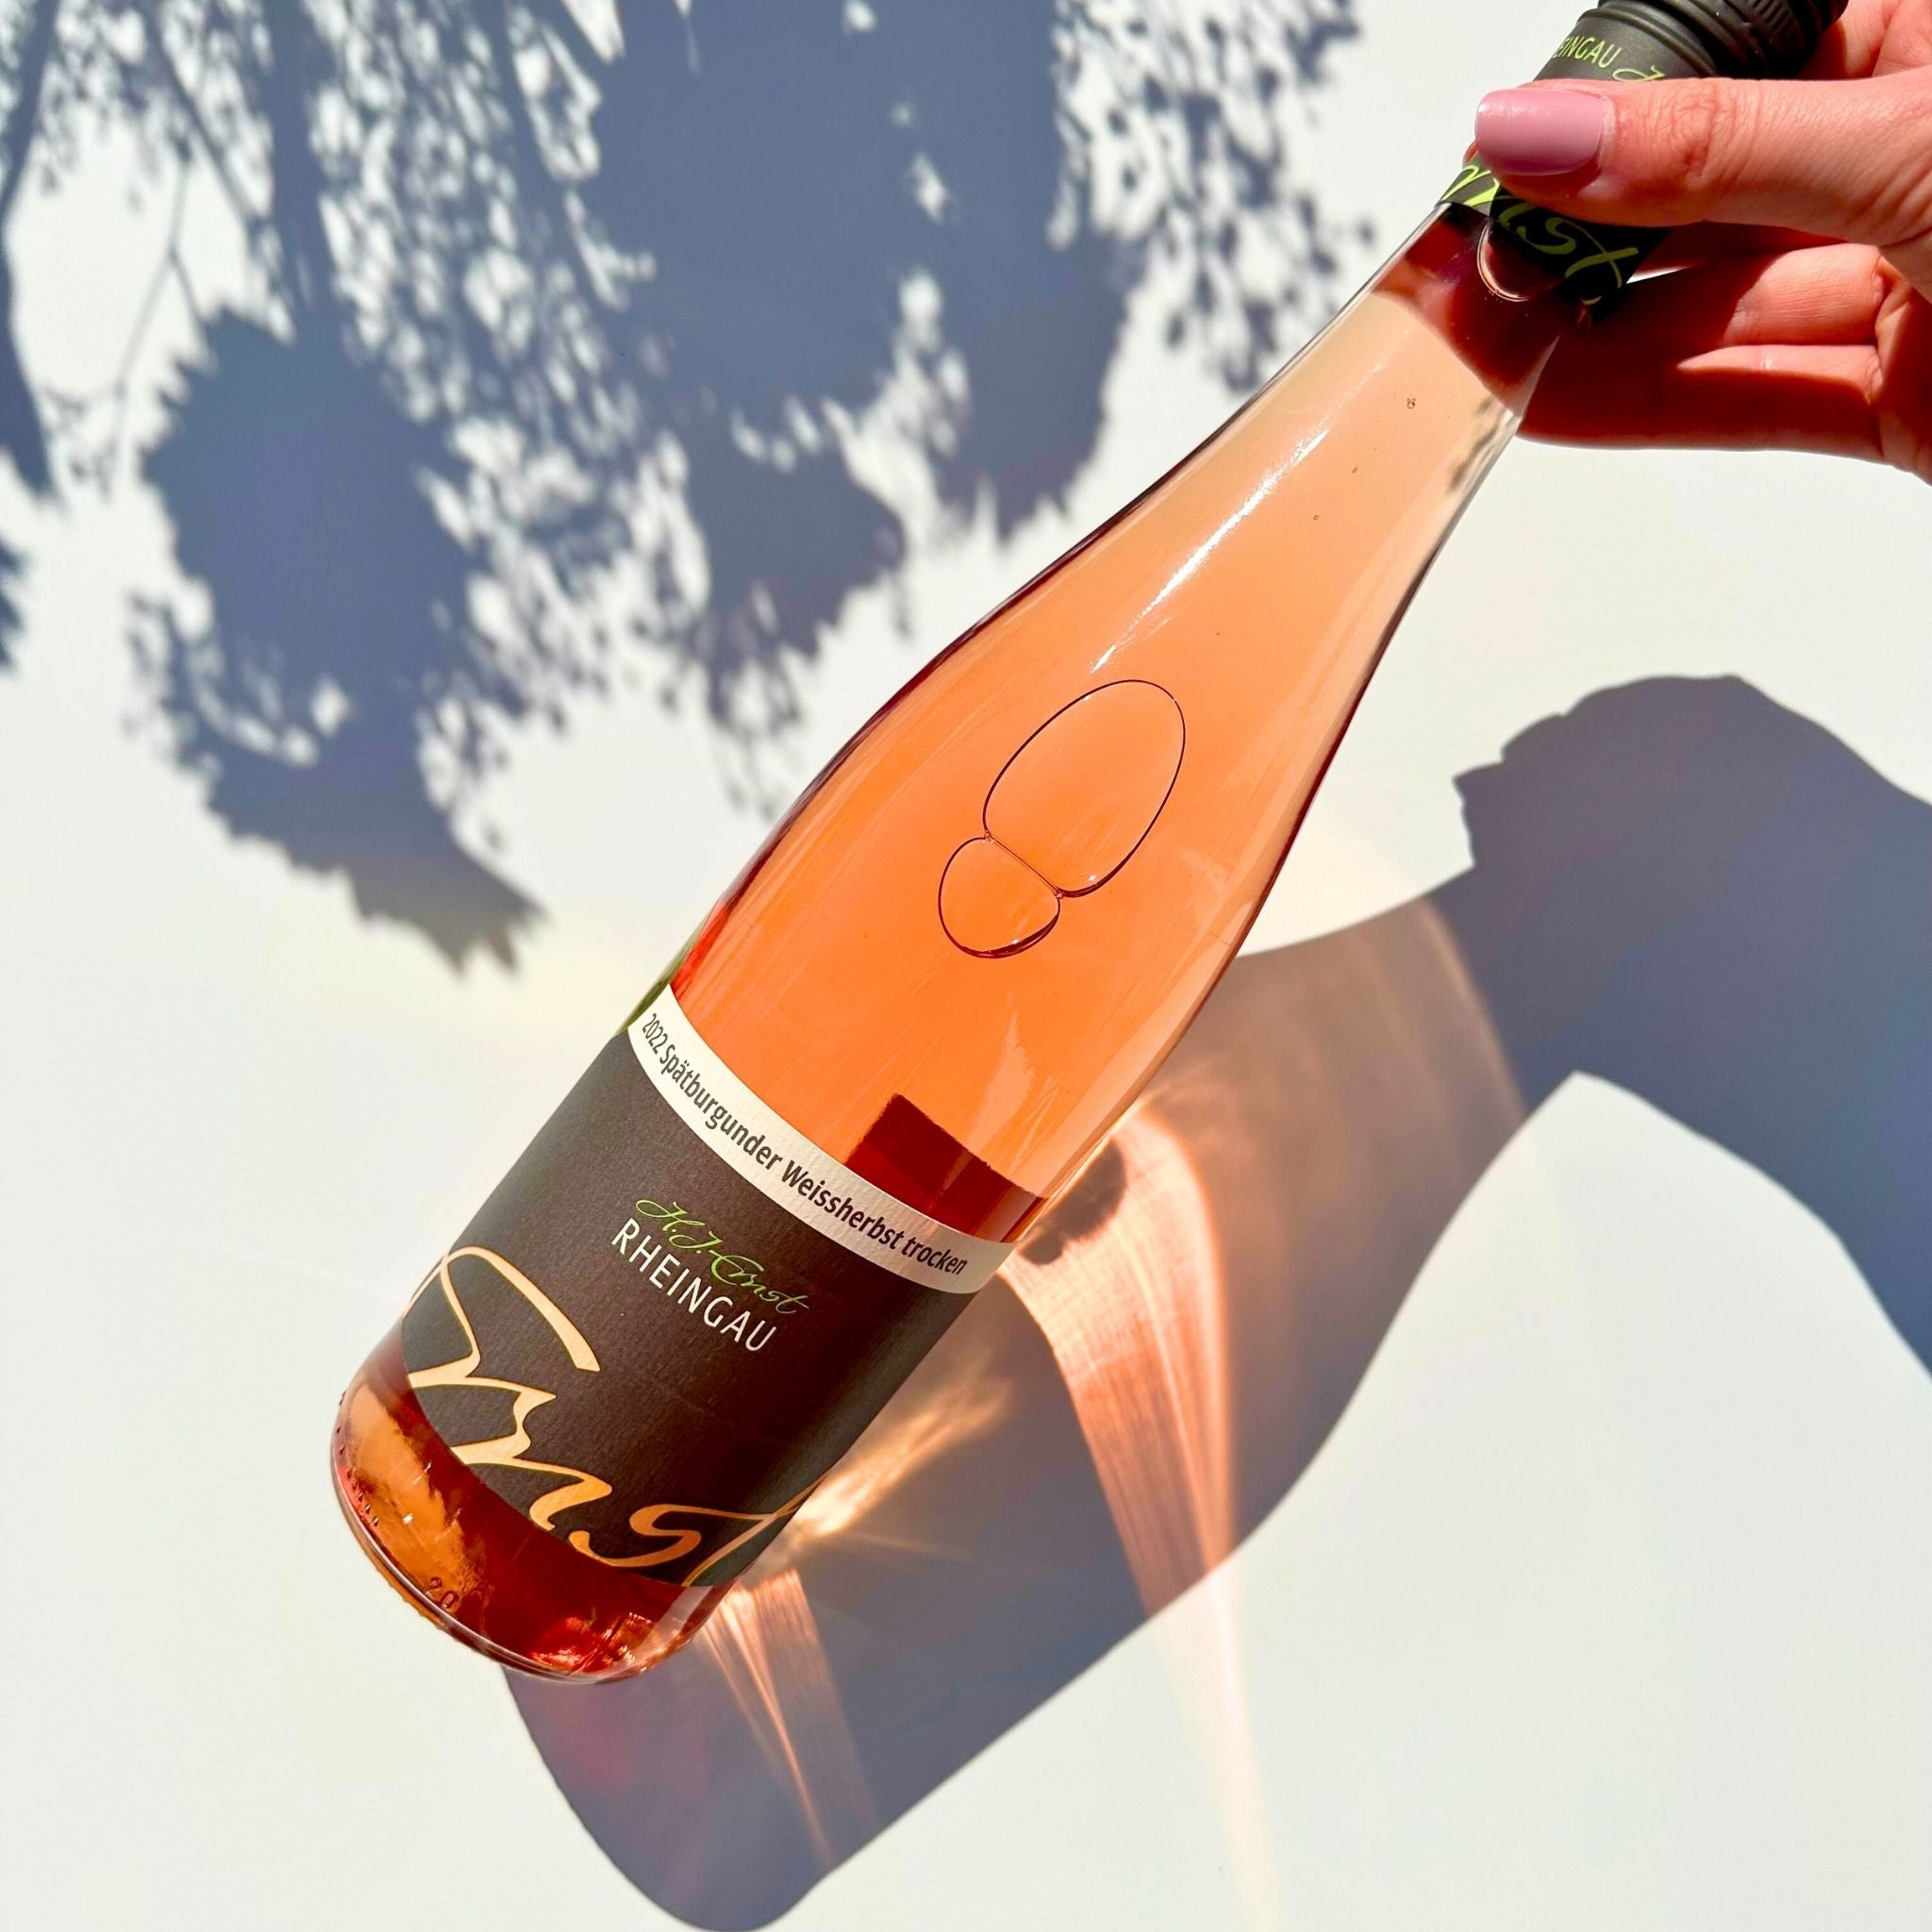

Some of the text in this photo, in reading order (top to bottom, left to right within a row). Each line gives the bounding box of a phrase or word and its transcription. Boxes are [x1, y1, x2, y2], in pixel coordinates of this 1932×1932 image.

[641, 1012, 968, 1275] 2022 Spätburgunder Weissherbst trocken
[611, 1217, 777, 1352] RHEINGAU
